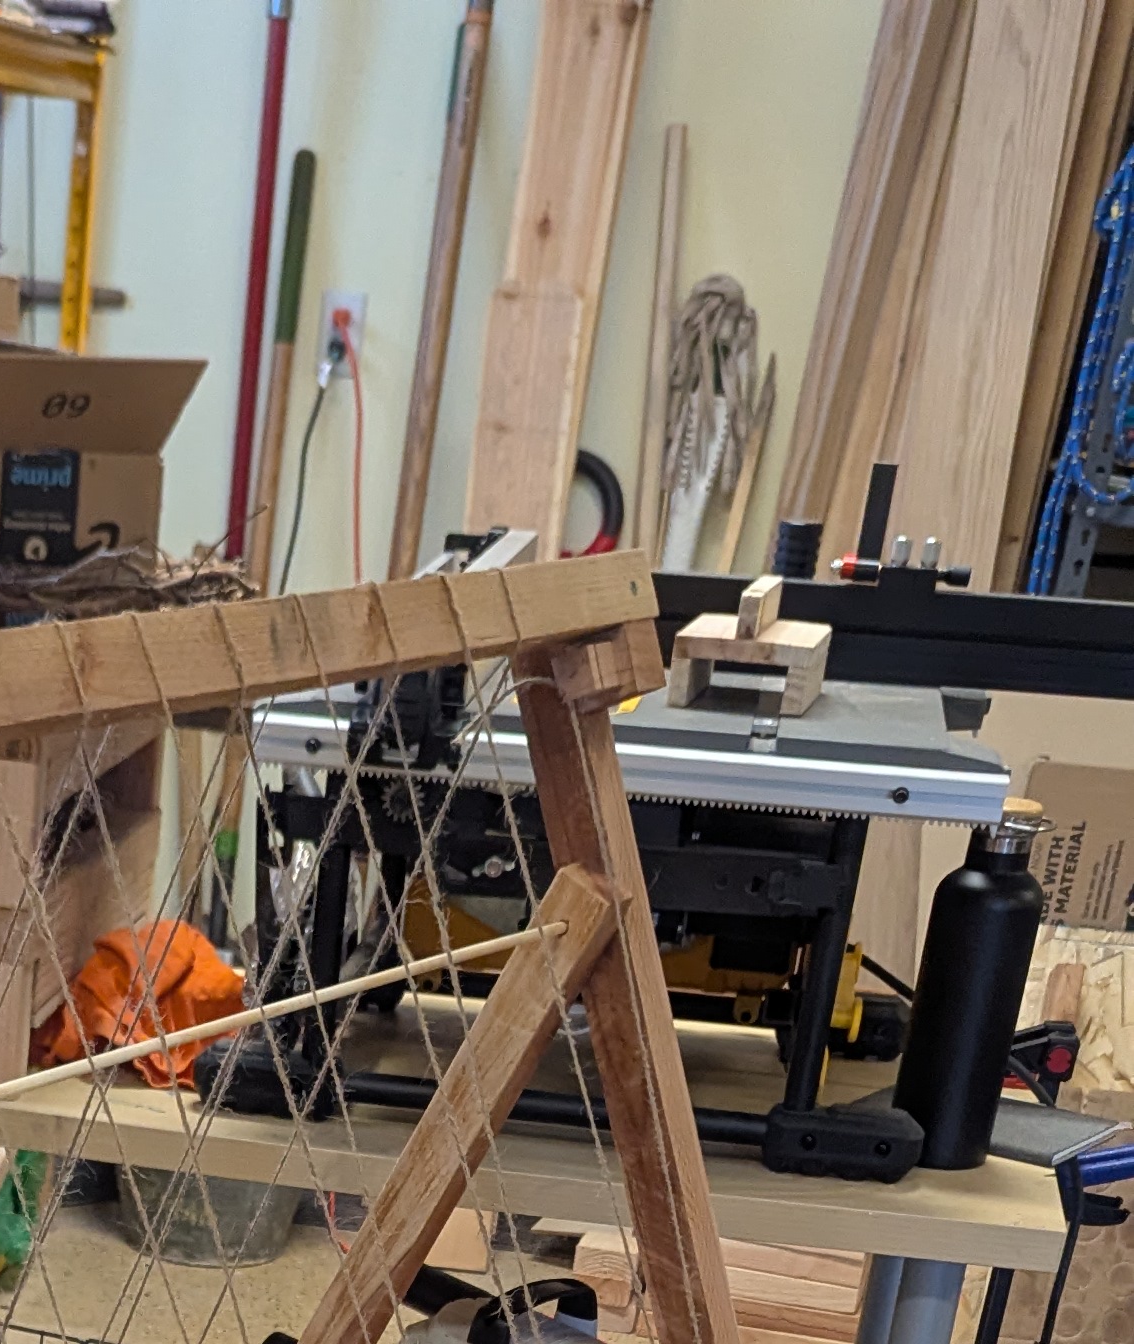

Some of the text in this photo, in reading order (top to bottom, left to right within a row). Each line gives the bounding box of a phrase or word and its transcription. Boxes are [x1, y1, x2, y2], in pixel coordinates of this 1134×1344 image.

[10, 464, 72, 493] prime
[1042, 836, 1066, 886] WITH
[1054, 821, 1086, 914] MATERIAL
